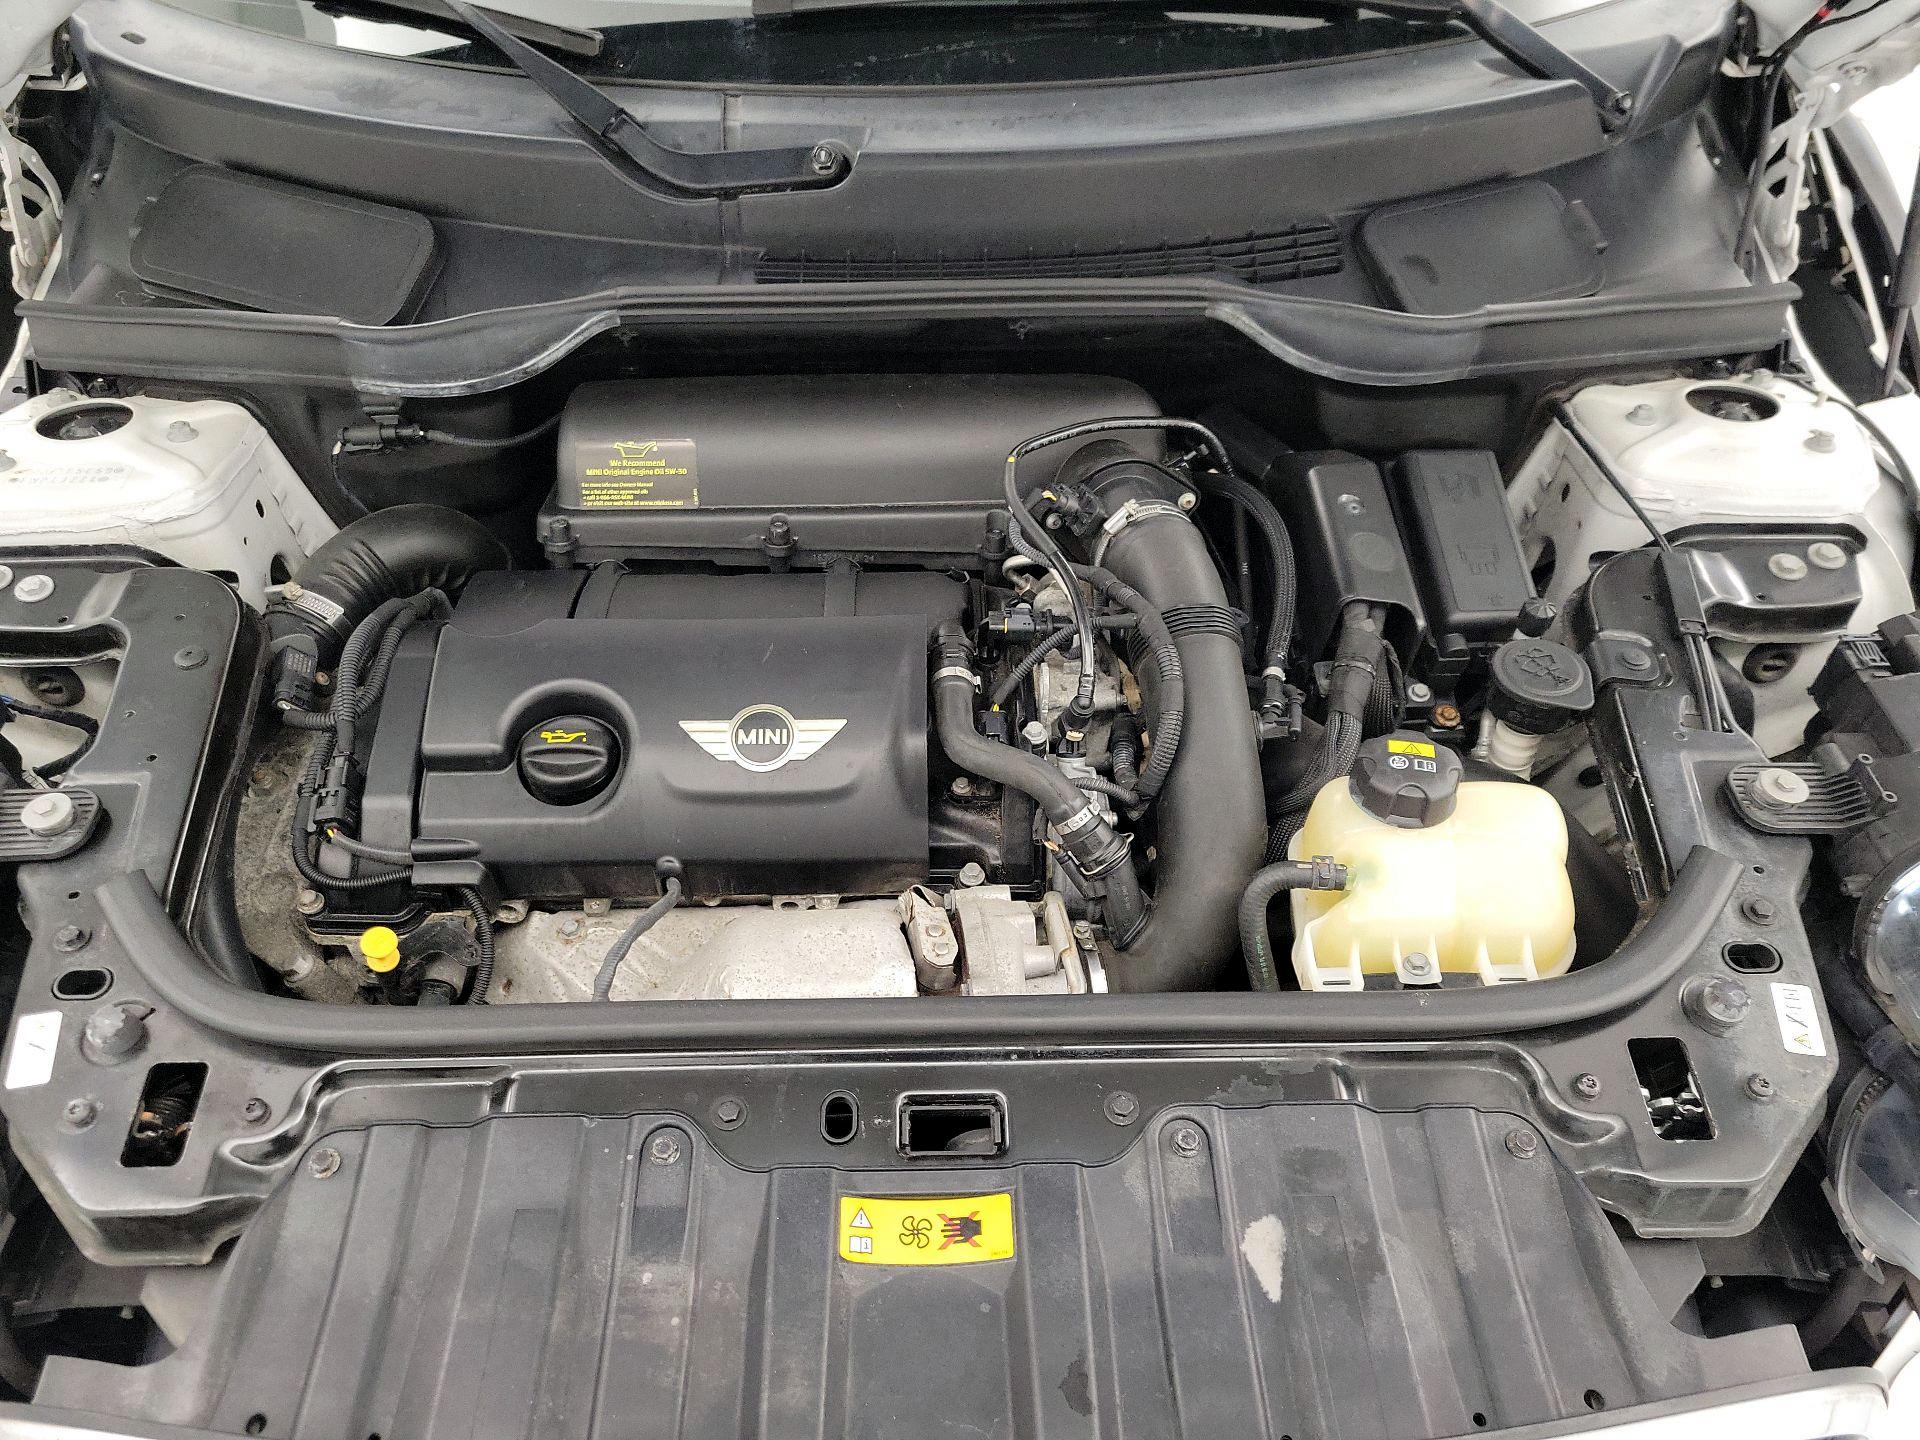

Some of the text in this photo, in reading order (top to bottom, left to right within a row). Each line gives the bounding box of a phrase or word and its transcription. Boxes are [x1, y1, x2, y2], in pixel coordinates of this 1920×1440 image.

[609, 459, 665, 467] We Recommend
[603, 468, 629, 476] Original
[630, 468, 653, 476] Engine
[665, 467, 688, 475] 5W-30
[738, 728, 788, 745] MINI
